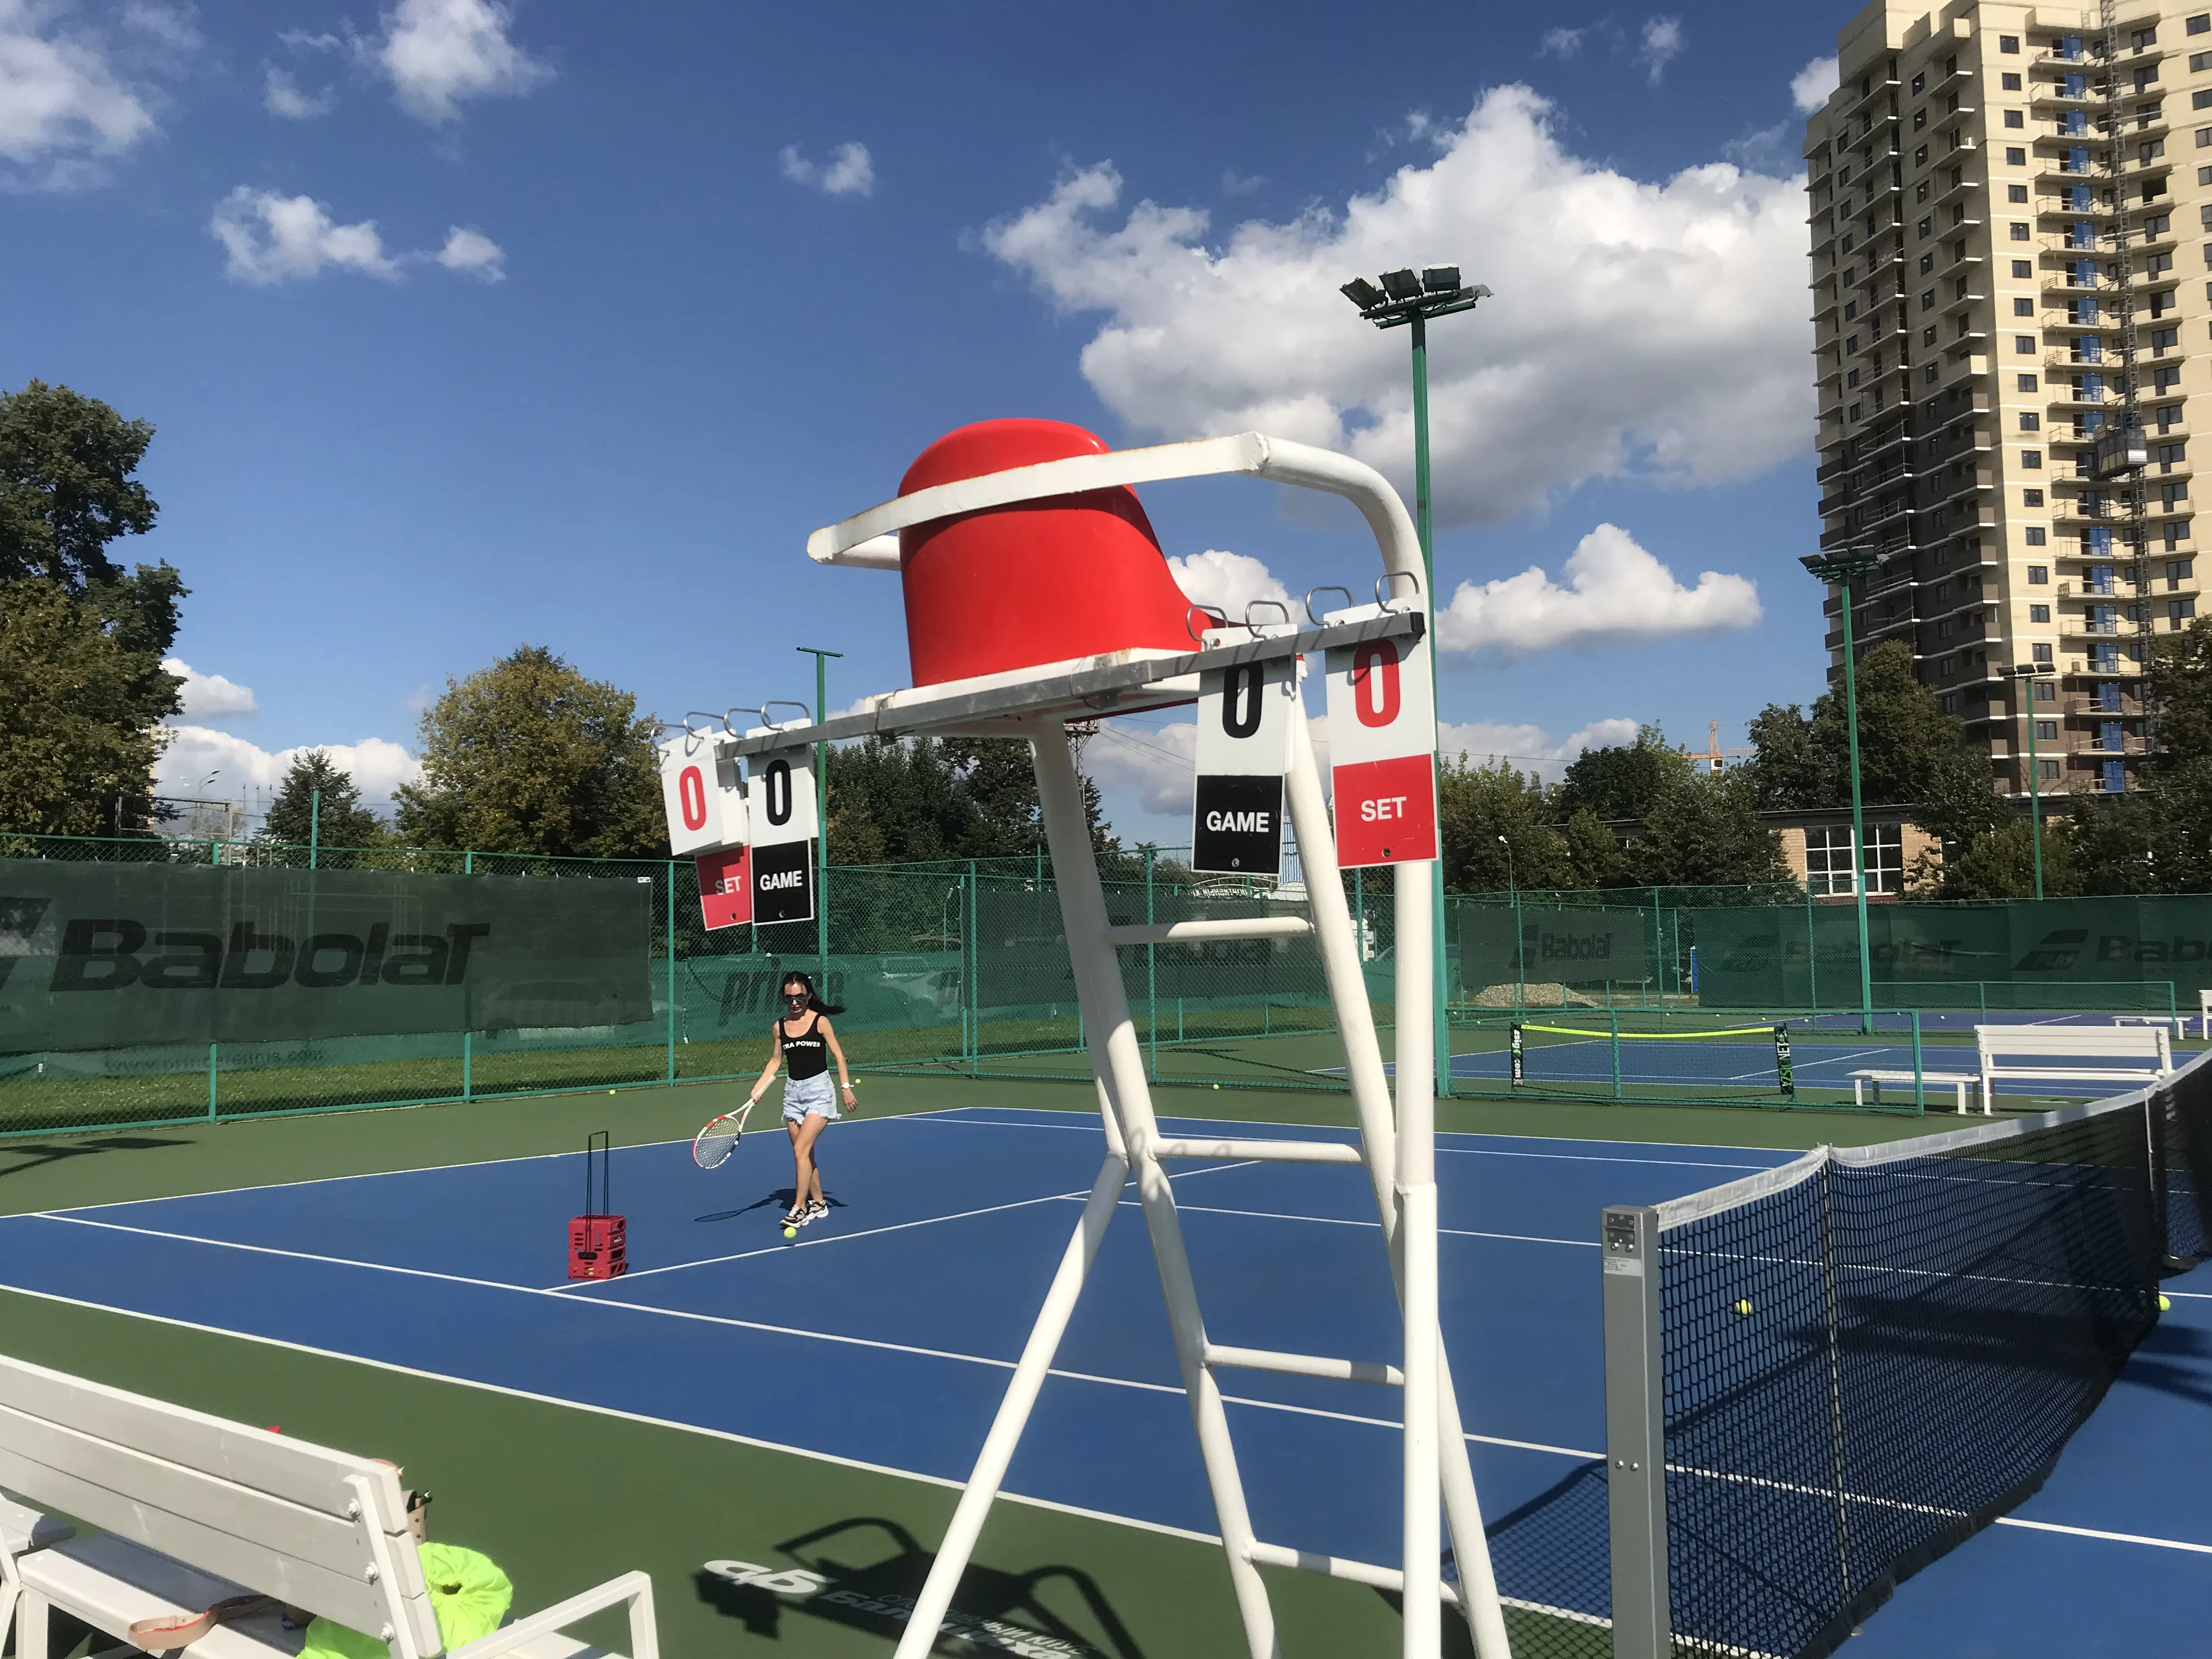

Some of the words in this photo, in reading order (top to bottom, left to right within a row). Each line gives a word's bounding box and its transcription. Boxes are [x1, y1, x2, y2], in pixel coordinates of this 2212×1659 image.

[1222, 662, 1264, 739] 0
[1353, 638, 1401, 728] 0
[679, 765, 707, 831] 0
[765, 759, 792, 826] 0
[1206, 811, 1269, 833] GAME
[1361, 796, 1407, 822] SET
[715, 876, 742, 895] SET
[760, 870, 803, 891] GAME
[819, 1589, 1071, 1659] Балшиха
